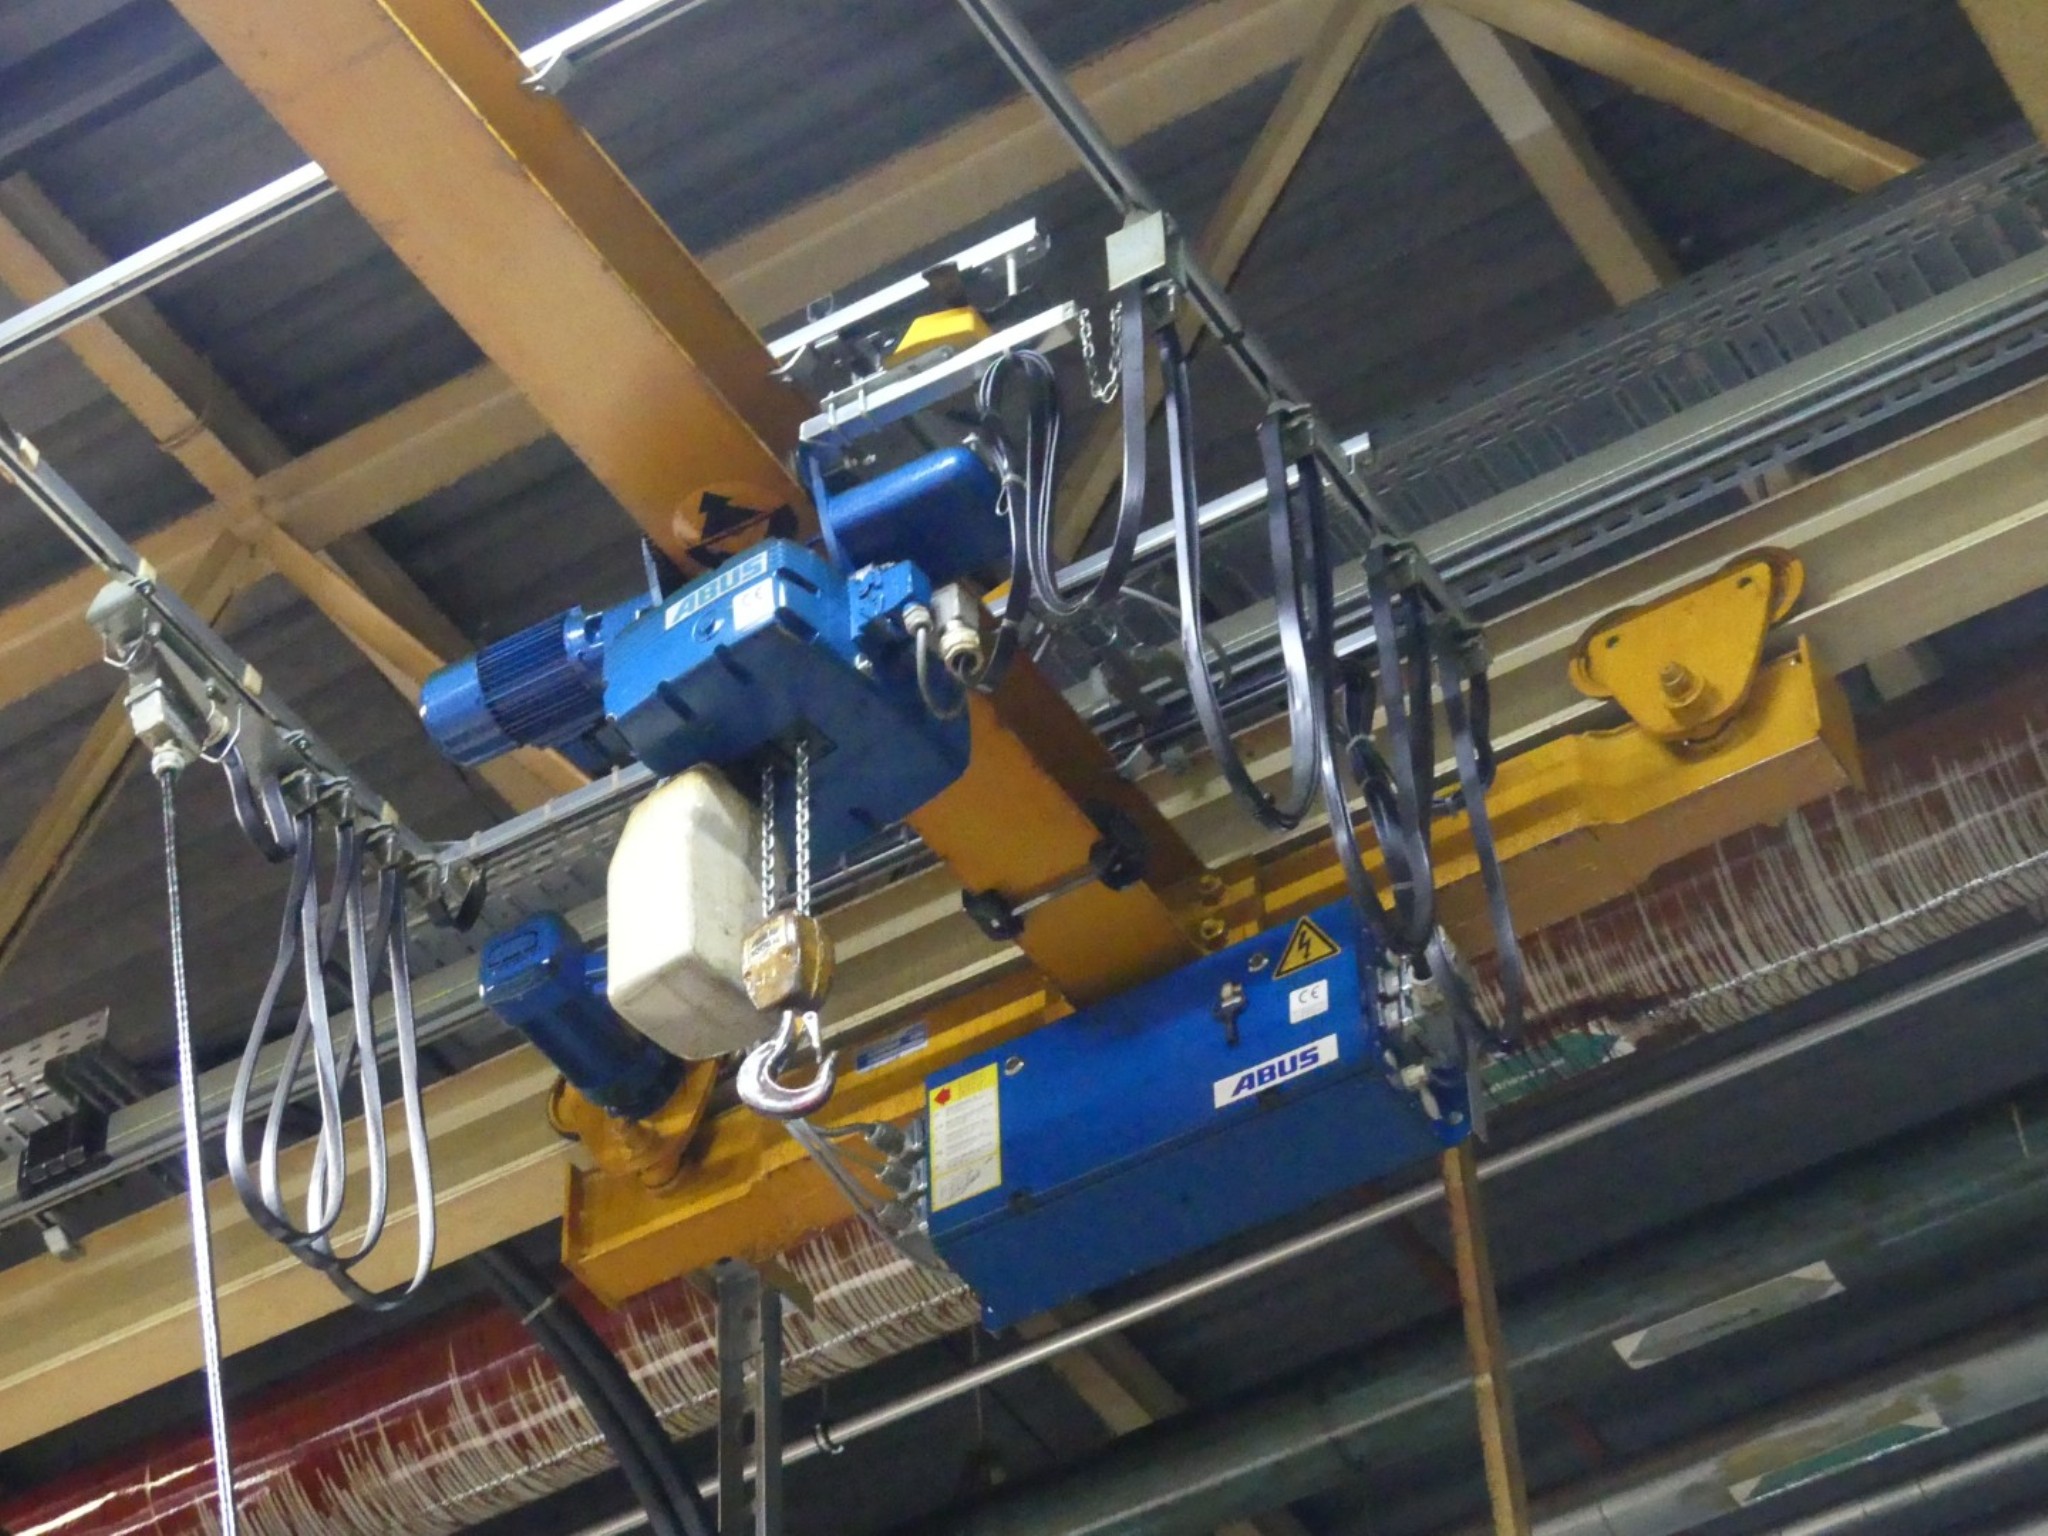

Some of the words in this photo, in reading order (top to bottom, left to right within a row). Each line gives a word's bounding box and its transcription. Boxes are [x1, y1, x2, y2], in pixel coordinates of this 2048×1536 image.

[672, 557, 763, 621] ABUS
[1297, 985, 1320, 1004] CE
[1231, 1046, 1319, 1097] ABUS
